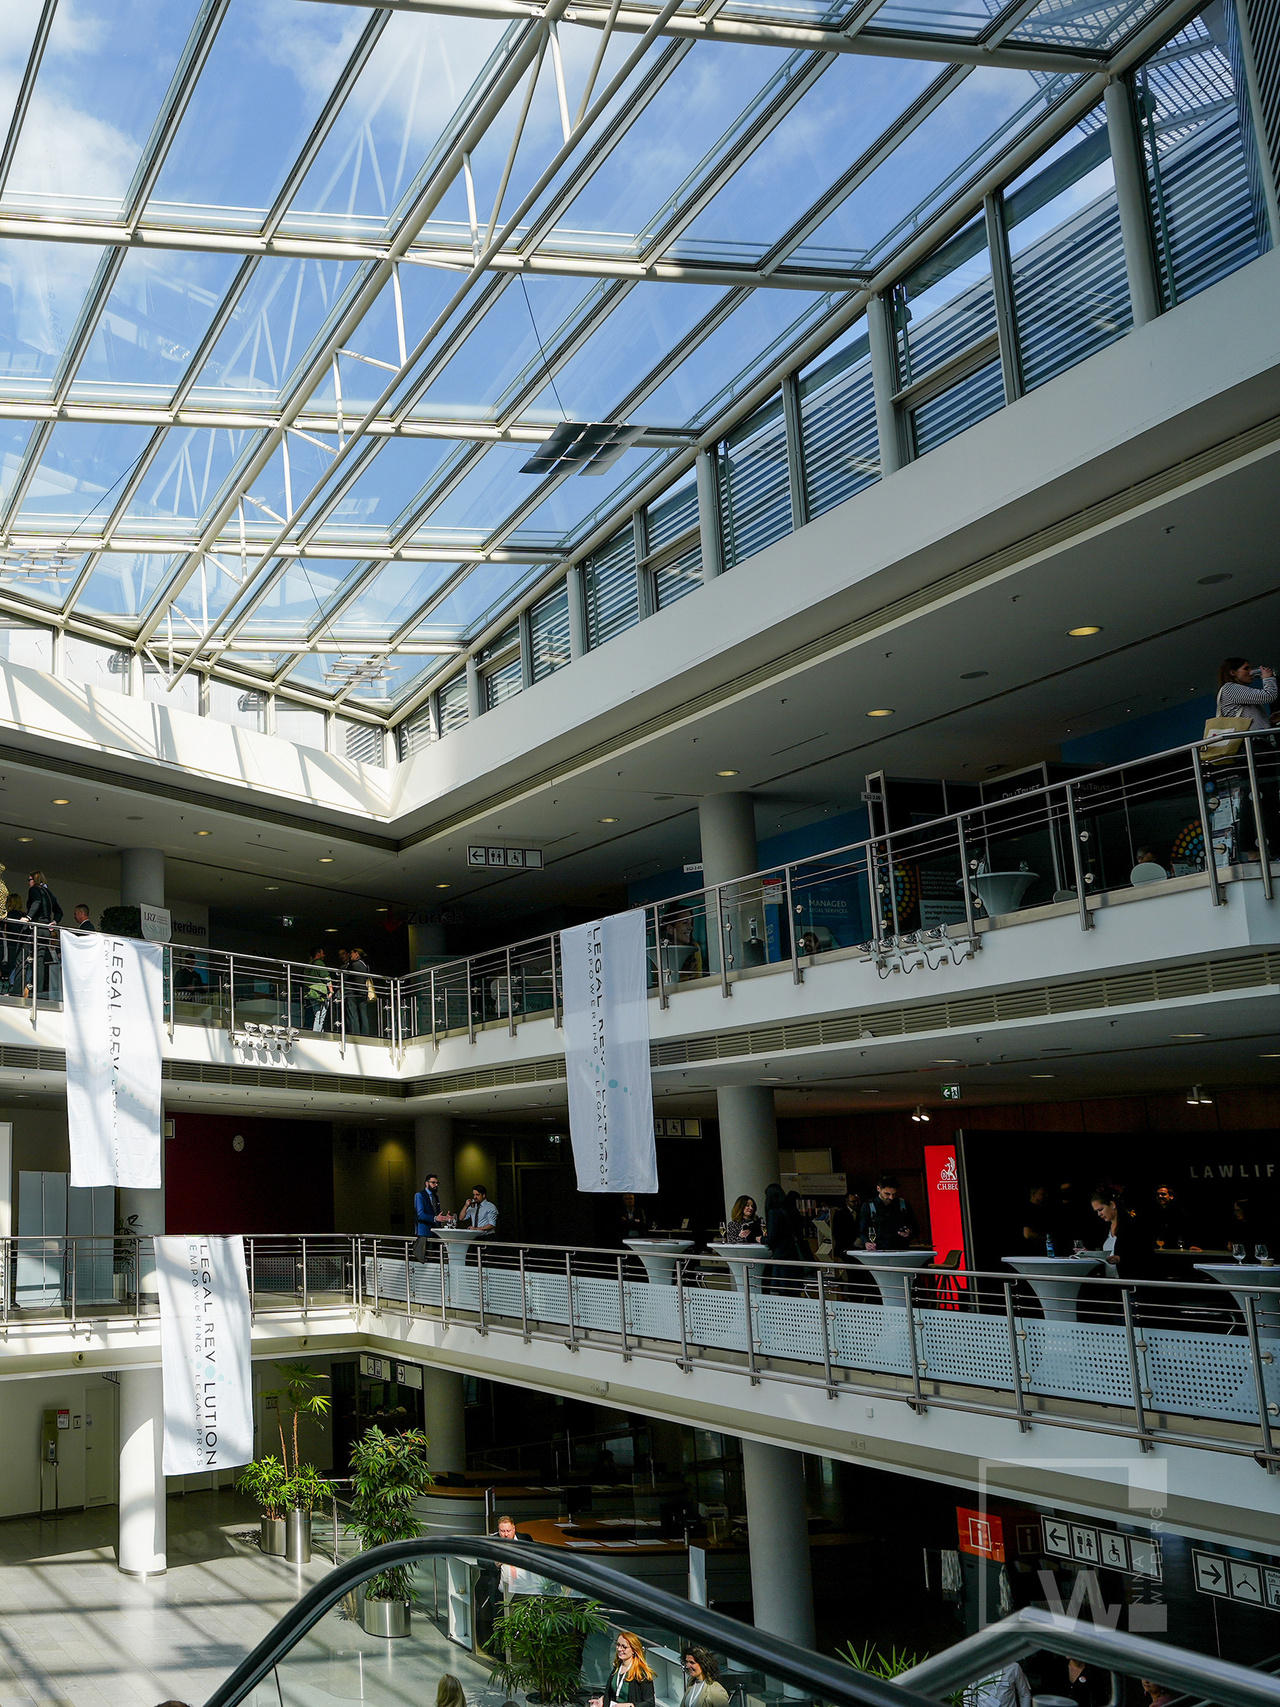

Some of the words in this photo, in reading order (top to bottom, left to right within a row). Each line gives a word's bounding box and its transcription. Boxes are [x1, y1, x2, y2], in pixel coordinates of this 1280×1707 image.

[144, 911, 157, 923] LRZ
[809, 899, 847, 908] MANAGED
[171, 921, 207, 936] terdam
[592, 926, 603, 1008] LEGAL
[586, 930, 598, 1055] EMPOWERING
[1189, 1164, 1275, 1178] LAWLIF
[200, 1245, 212, 1313] LEGAL
[189, 1244, 202, 1353] EMPOWERING
[196, 1428, 204, 1467] PROS
